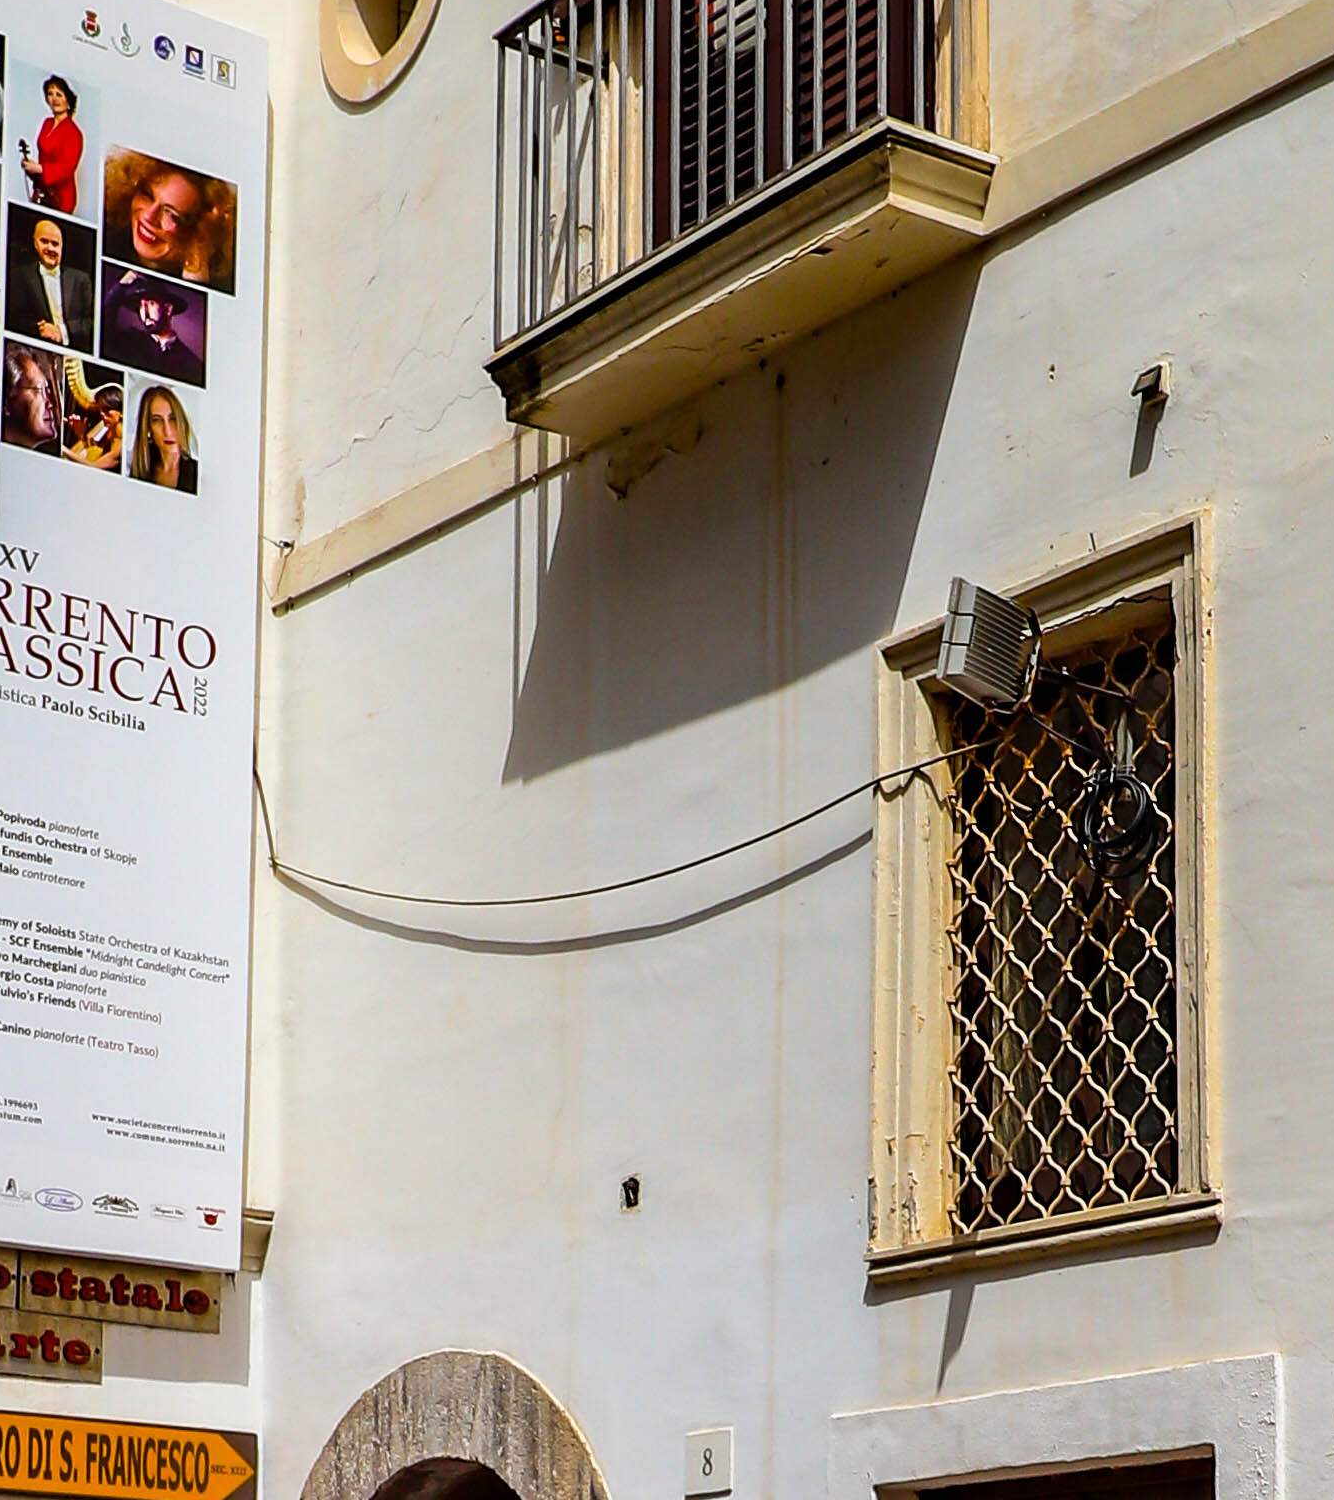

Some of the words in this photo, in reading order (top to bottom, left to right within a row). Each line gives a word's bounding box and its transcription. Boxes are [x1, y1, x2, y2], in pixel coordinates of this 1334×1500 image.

[193, 676, 208, 717] 2022
[41, 695, 85, 718] Paolo
[88, 706, 146, 731] Scibilia
[48, 821, 99, 840] pianoforte
[1, 845, 53, 865] Ensemble
[21, 869, 86, 889] controtenore
[37, 992, 77, 1009] Friends
[79, 999, 104, 1014] (Villa
[107, 1004, 162, 1025] Fiorentino)
[33, 1028, 85, 1045] pianoforte
[87, 1035, 124, 1052] (Teatro
[127, 1042, 159, 1059] Tasso)
[30, 1267, 211, 1316] statale
[28, 1426, 54, 1481] DI
[60, 1430, 79, 1484] S.
[85, 1432, 211, 1494] FRANCESCO
[702, 1448, 713, 1477] 8
